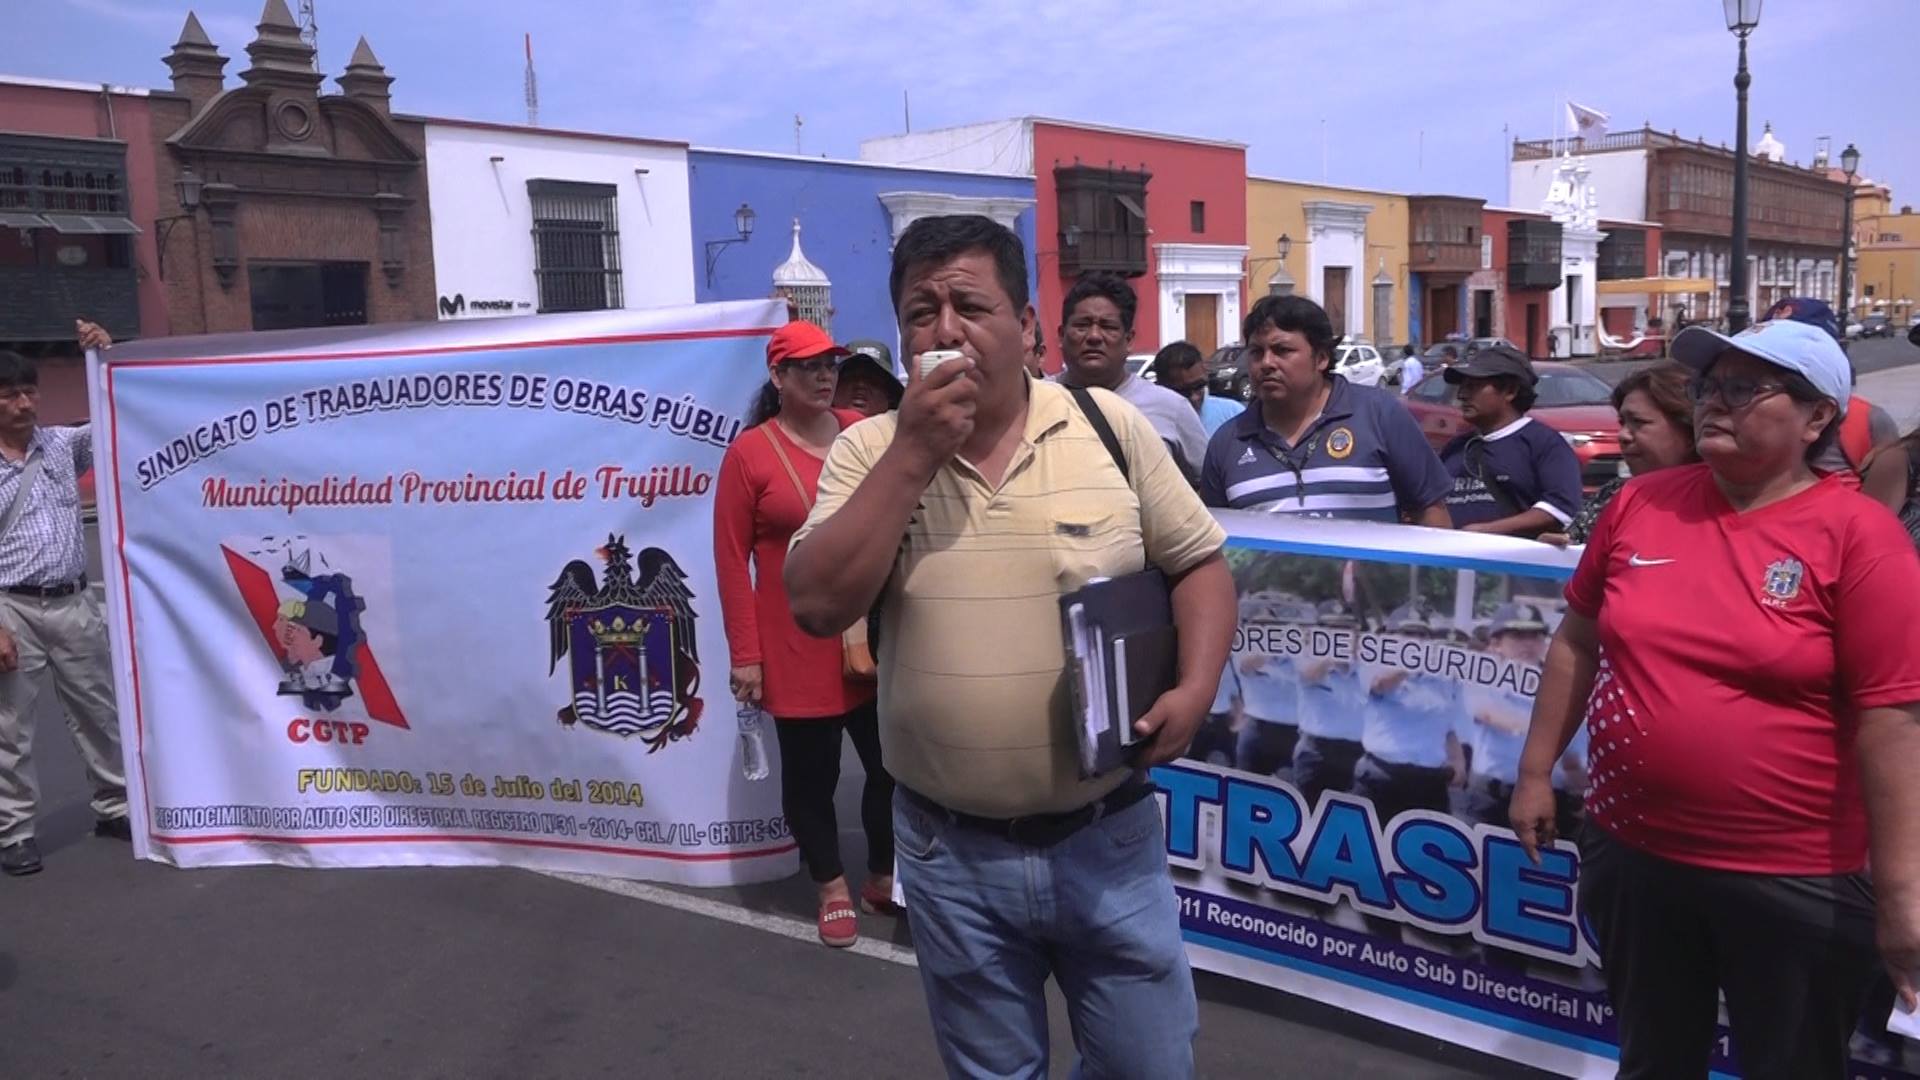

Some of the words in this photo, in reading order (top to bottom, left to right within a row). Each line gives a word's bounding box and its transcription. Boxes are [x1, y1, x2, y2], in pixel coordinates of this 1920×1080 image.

[470, 300, 513, 310] movistar
[136, 408, 258, 488] SINDICATO
[265, 396, 298, 428] DE
[302, 374, 502, 421] TRABAJADORES
[509, 375, 548, 404] DE
[553, 378, 647, 420] OBRAS
[651, 395, 741, 445] PÚBLI
[202, 475, 393, 514] Municipalidad
[399, 470, 546, 504] Provincial
[552, 470, 587, 499] de
[595, 465, 712, 508] Trujillo
[1312, 631, 1352, 661] DE
[1359, 632, 1541, 697] SEGURIDAD
[287, 718, 370, 745] CGTP
[297, 769, 422, 795] FUNDADO:
[426, 771, 455, 796] 15
[460, 773, 487, 797] de
[491, 775, 545, 800] Julio
[550, 778, 582, 802] del
[588, 780, 644, 807] 2014
[272, 806, 302, 830] POR
[303, 806, 347, 830] AUTO
[349, 805, 382, 829] SUB
[384, 805, 473, 830] DIRECTORAL
[472, 809, 541, 834] REGISTRO
[1148, 762, 1603, 965] TRASE
[1207, 902, 1318, 949] Reconocido
[1322, 934, 1357, 958] por
[1360, 942, 1409, 974] Auto
[1414, 956, 1457, 986] Sub
[1462, 968, 1578, 1019] Directorial
[1586, 1003, 1614, 1025] N°
